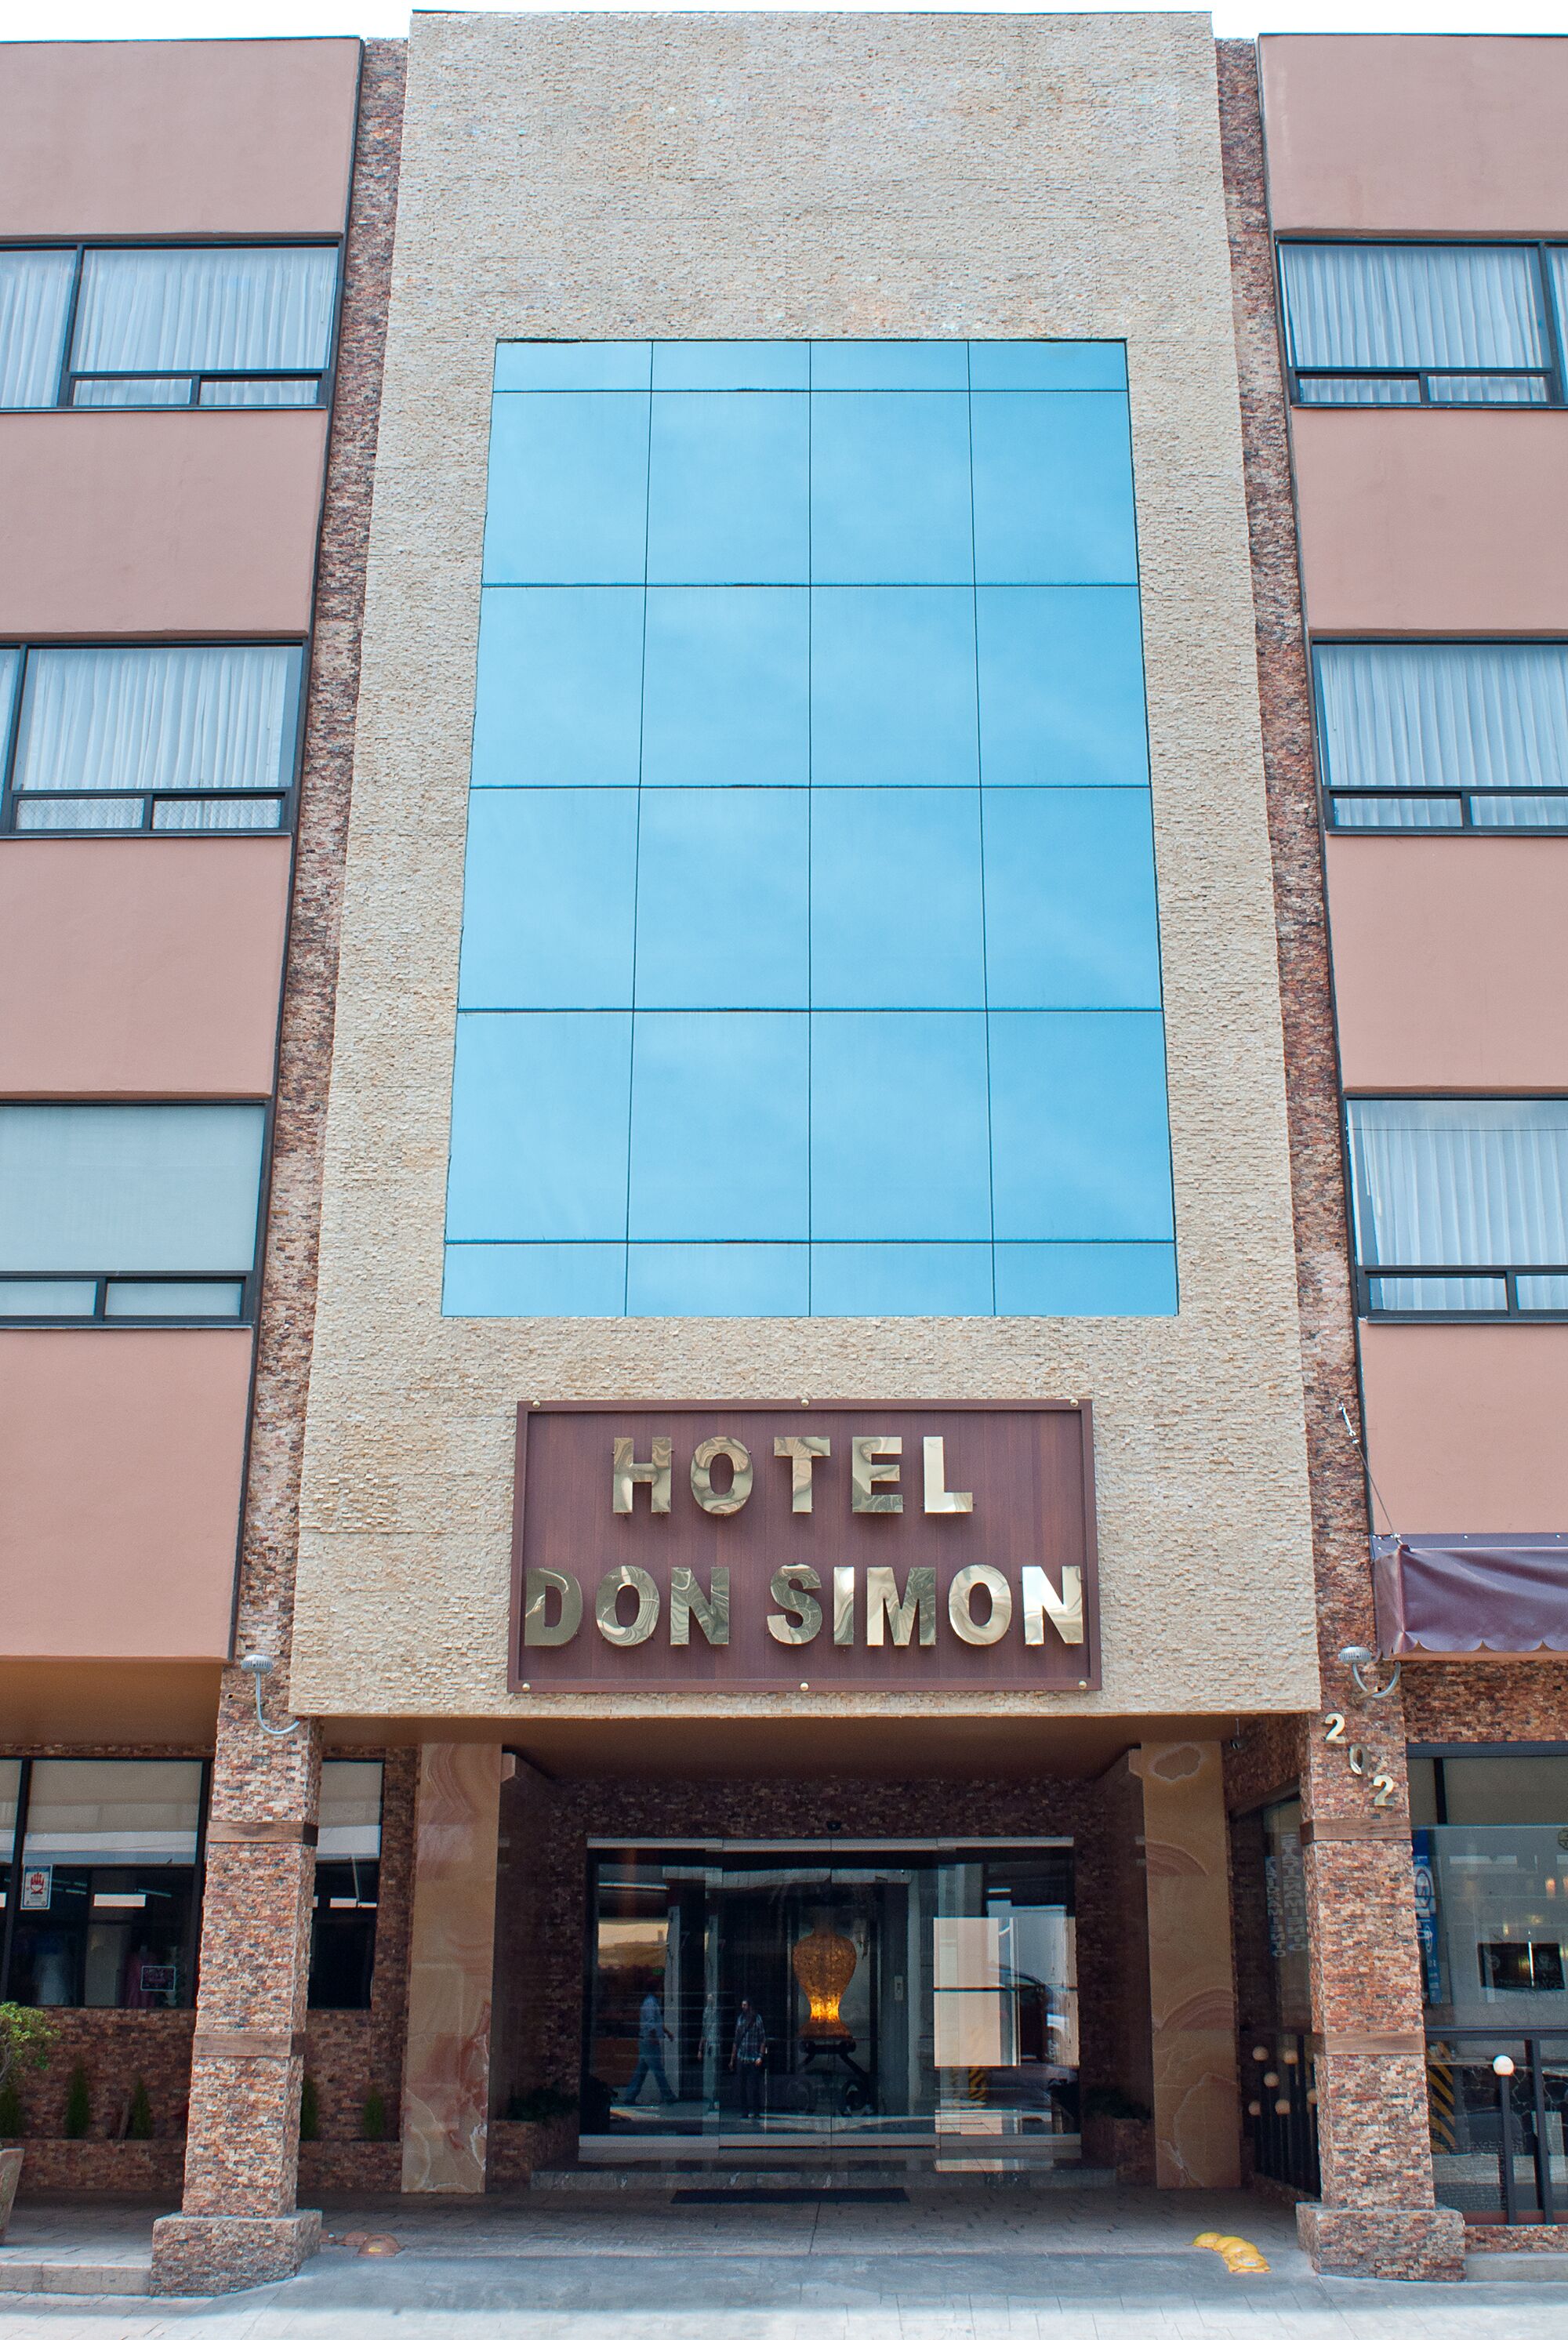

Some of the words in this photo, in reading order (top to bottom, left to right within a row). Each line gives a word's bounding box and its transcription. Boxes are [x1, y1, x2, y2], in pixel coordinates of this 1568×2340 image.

[612, 1435, 974, 1515] HOTEL
[524, 1565, 730, 1646] DON
[767, 1563, 1083, 1645] SIMON
